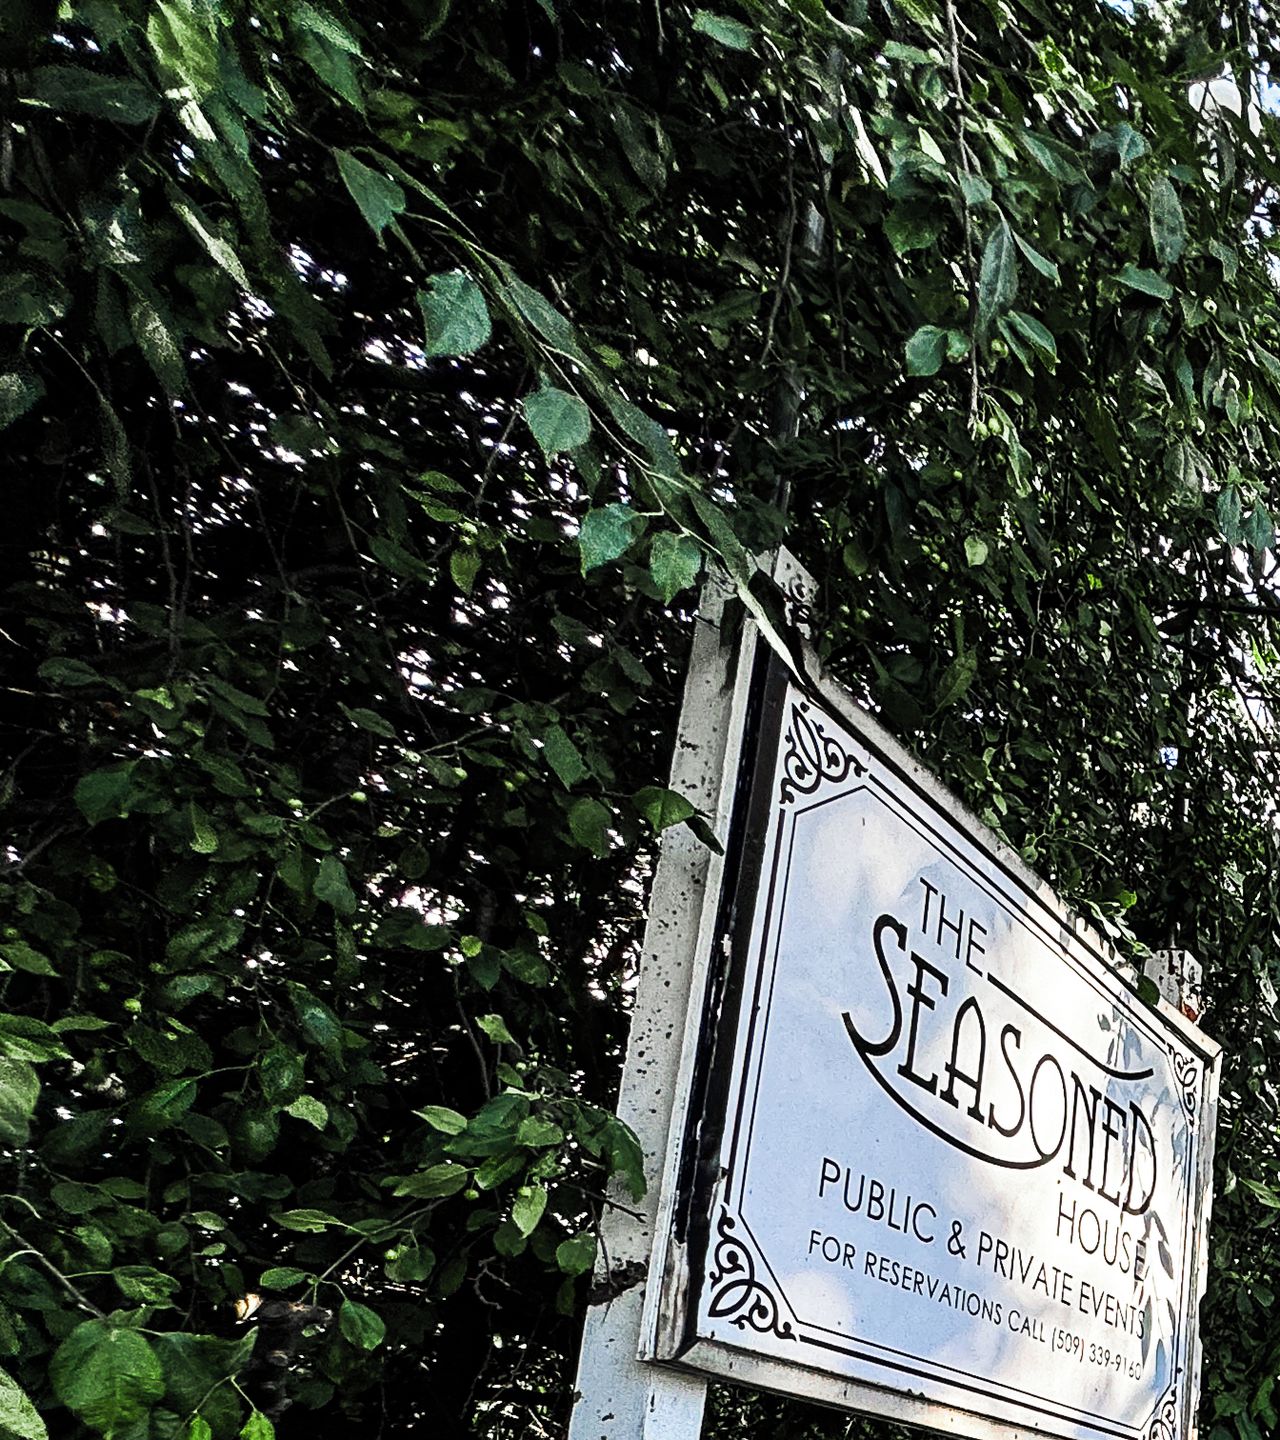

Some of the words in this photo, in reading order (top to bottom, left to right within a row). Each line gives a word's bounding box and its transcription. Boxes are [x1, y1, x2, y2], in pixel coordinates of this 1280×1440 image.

[919, 876, 988, 978] THE
[841, 913, 1158, 1216] SEASONED
[808, 1229, 856, 1270] FOR
[863, 1251, 1003, 1326] RESERVATIONS
[1007, 1309, 1046, 1343] CALL
[1051, 1326, 1085, 1363] (509)
[818, 1156, 937, 1244] PUBLIC
[947, 1219, 966, 1260] &
[976, 1231, 1074, 1307] PRIVATE
[1078, 1280, 1145, 1340] EVENTS
[1056, 1191, 1147, 1282] HOUSE
